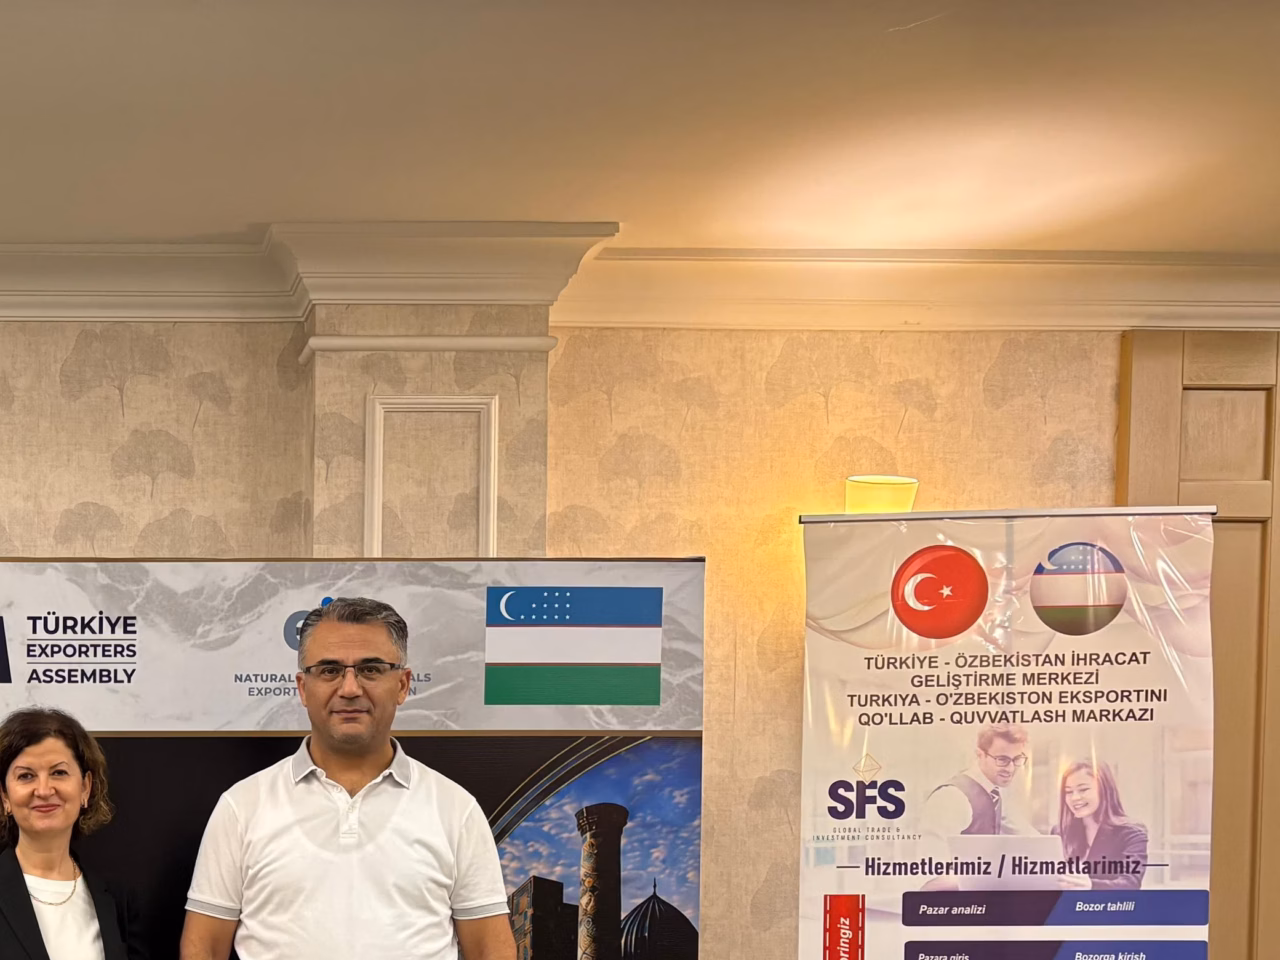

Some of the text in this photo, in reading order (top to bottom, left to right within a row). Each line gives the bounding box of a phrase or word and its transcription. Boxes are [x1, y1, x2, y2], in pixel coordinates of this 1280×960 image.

[27, 611, 136, 634] TÜRKİYE
[27, 644, 136, 657] EXPORTERS
[864, 651, 1150, 669] TÜRKİYE ÖZBEKİSTAN İHRACAT
[27, 669, 136, 683] ASSEMBLY
[234, 673, 295, 683] NATURAL
[911, 669, 1098, 690] GELİŞTİRME MERKEZİ
[847, 689, 1167, 707] TURKIYA O'ZBEKISTON EKSPORTINI
[859, 708, 1153, 726] QO'LLAB QUVVATLASH MARKAZI
[827, 779, 905, 820] SFS
[865, 855, 1141, 876] Hizmetlerimiz Hizmatlarimiz
[919, 905, 986, 914] Pazar analizi
[1076, 902, 1135, 911] Bozor tahlili
[1118, 952, 1146, 960] kirish
